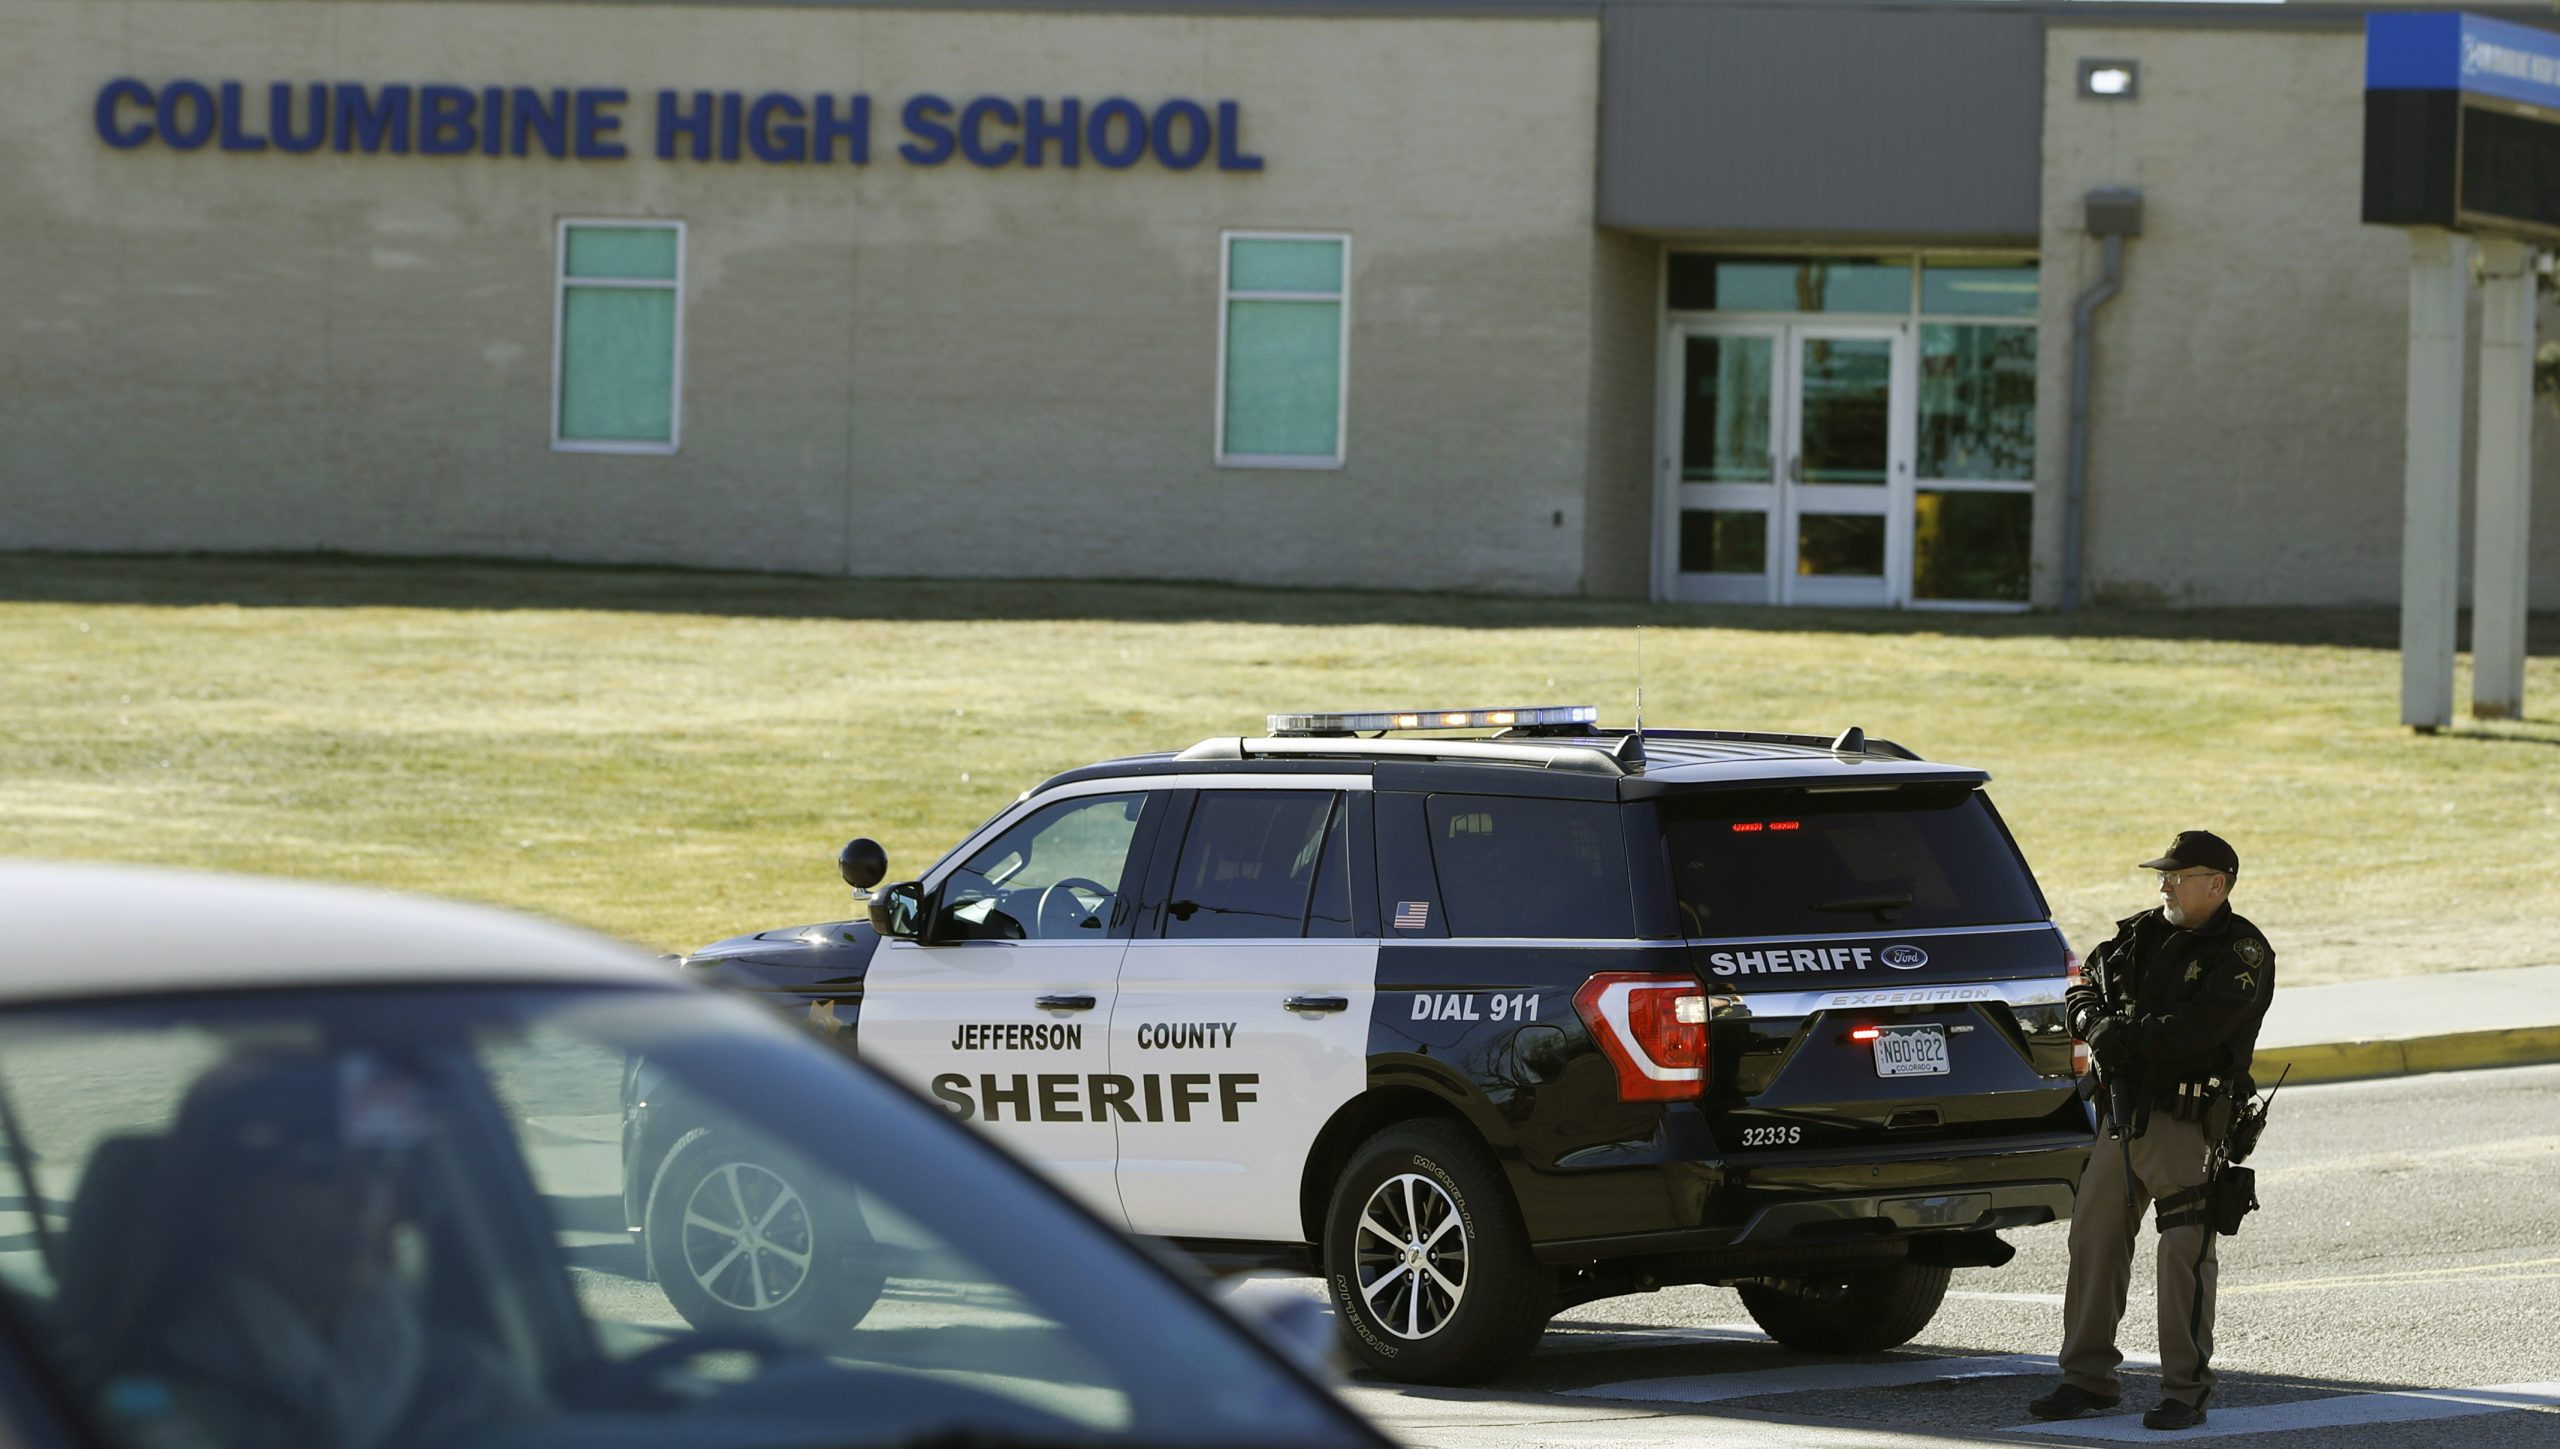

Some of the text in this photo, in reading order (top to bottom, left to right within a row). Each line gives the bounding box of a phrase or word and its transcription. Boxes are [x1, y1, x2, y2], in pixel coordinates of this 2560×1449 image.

[94, 78, 1264, 171] COLUMBINE HIGH SCHOOL
[1710, 947, 1872, 976] SHERIFF
[1411, 994, 1540, 1022] DIAL 911
[1831, 988, 1990, 1006] EXPEDITION
[951, 1022, 1237, 1050] JEFFERSON COUNTY
[1896, 1063, 1931, 1072] COLORADO
[931, 1073, 1259, 1122] SHERIFF
[1413, 1154, 1476, 1239] MICHELIN
[1336, 1274, 1400, 1358] MICHELIN
